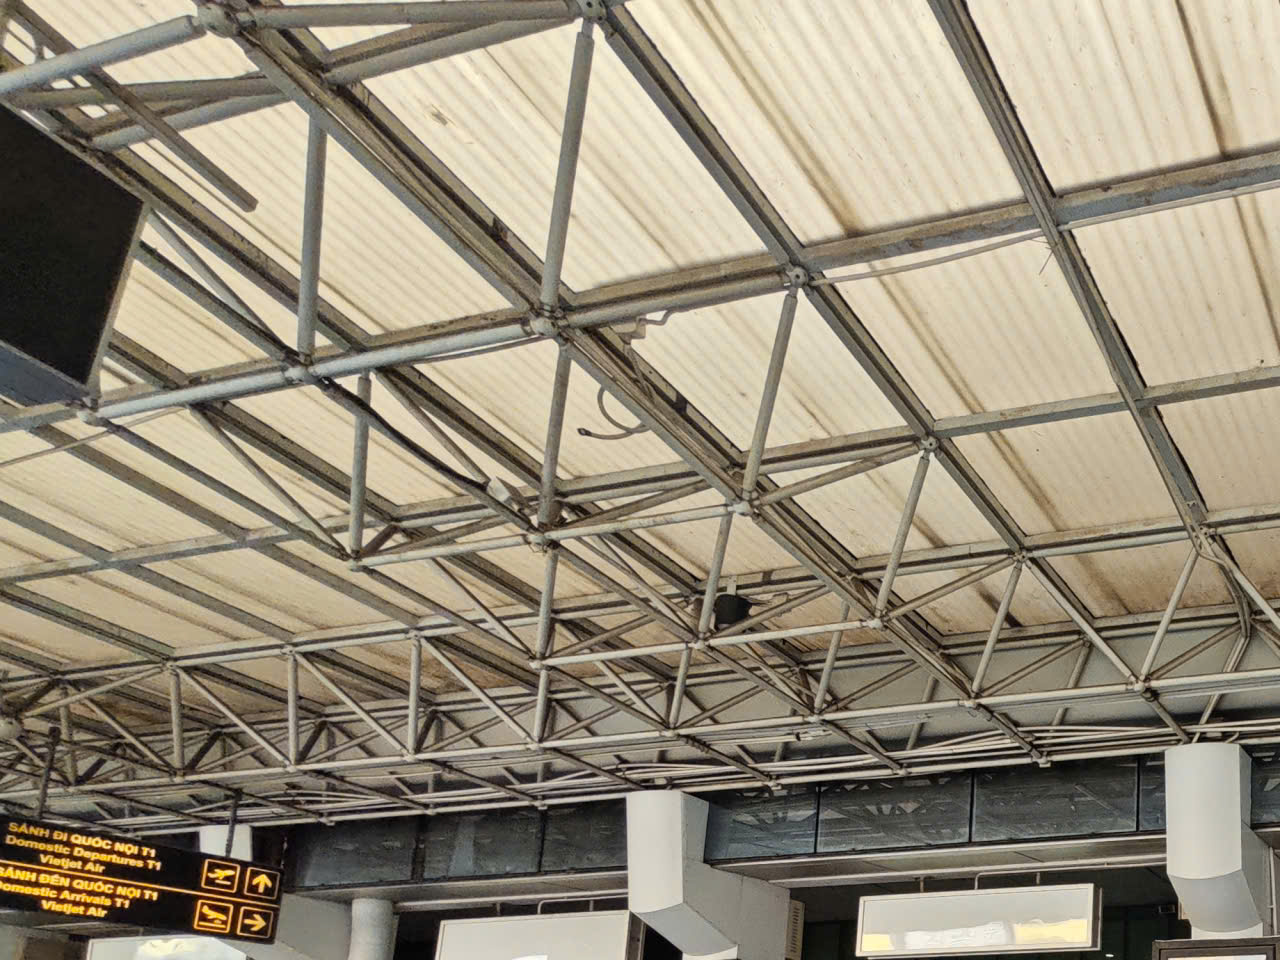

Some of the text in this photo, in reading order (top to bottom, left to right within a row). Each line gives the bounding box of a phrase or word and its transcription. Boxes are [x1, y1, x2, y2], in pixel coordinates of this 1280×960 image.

[5, 834, 162, 872] Domestic Departures T1
[140, 846, 157, 858] T1
[39, 853, 106, 874] Vietjet Air
[0, 881, 130, 910] omestic Arrivals T1
[143, 889, 159, 902] T1
[41, 899, 108, 919] Vietjet Air
